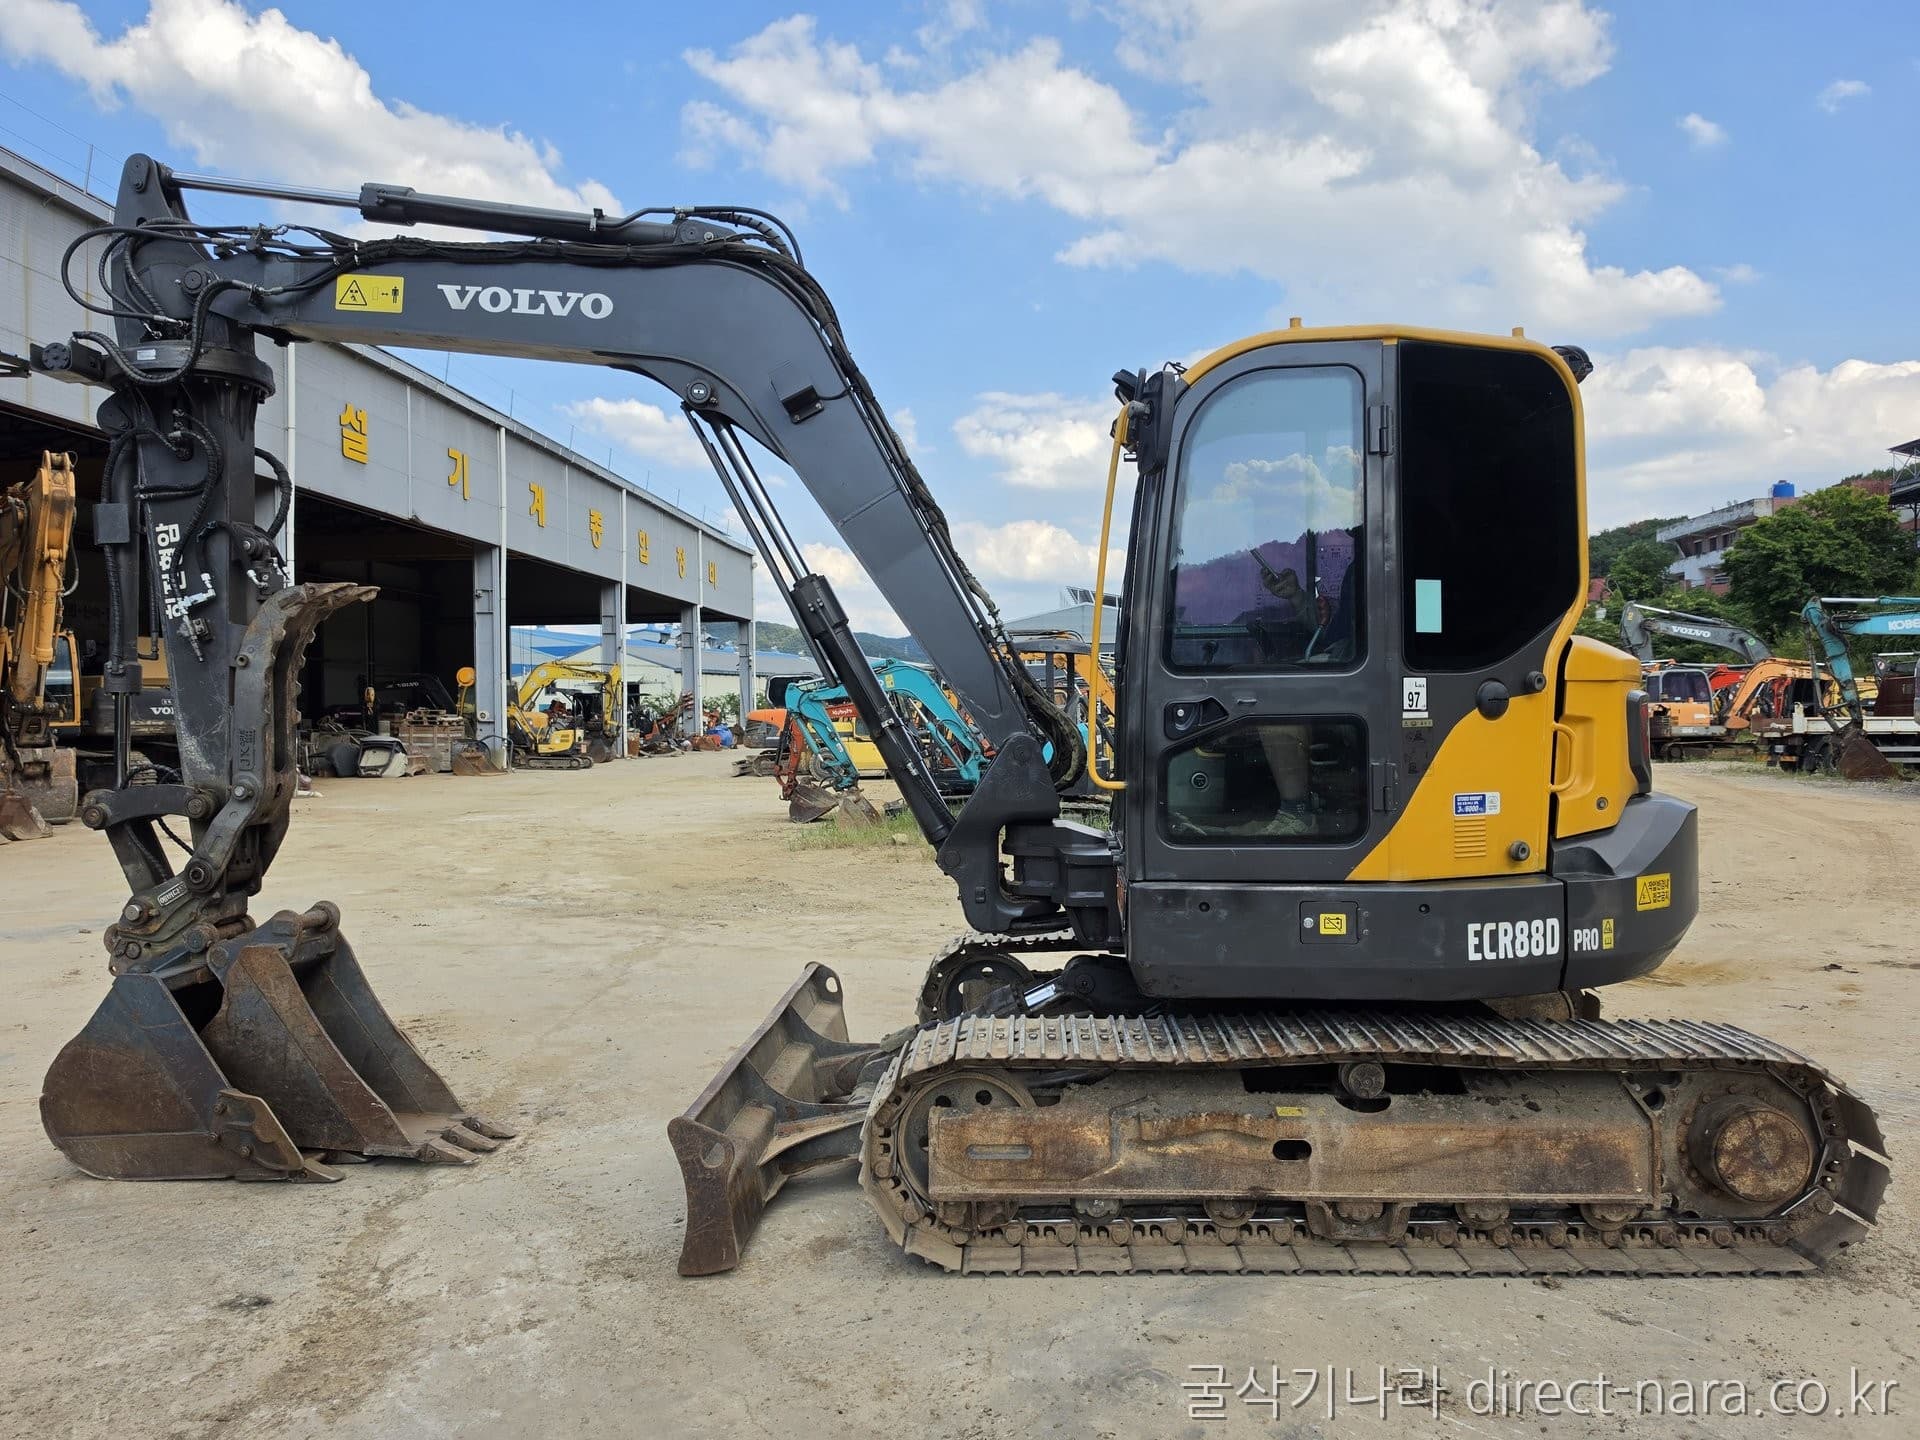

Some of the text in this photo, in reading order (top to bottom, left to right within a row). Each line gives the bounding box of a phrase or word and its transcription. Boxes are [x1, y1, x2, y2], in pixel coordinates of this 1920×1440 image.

[437, 284, 613, 319] VOLVO
[1672, 626, 1711, 638] VOLVO
[1408, 692, 1420, 708] 97
[1468, 918, 1599, 961] ECR88D PRO
